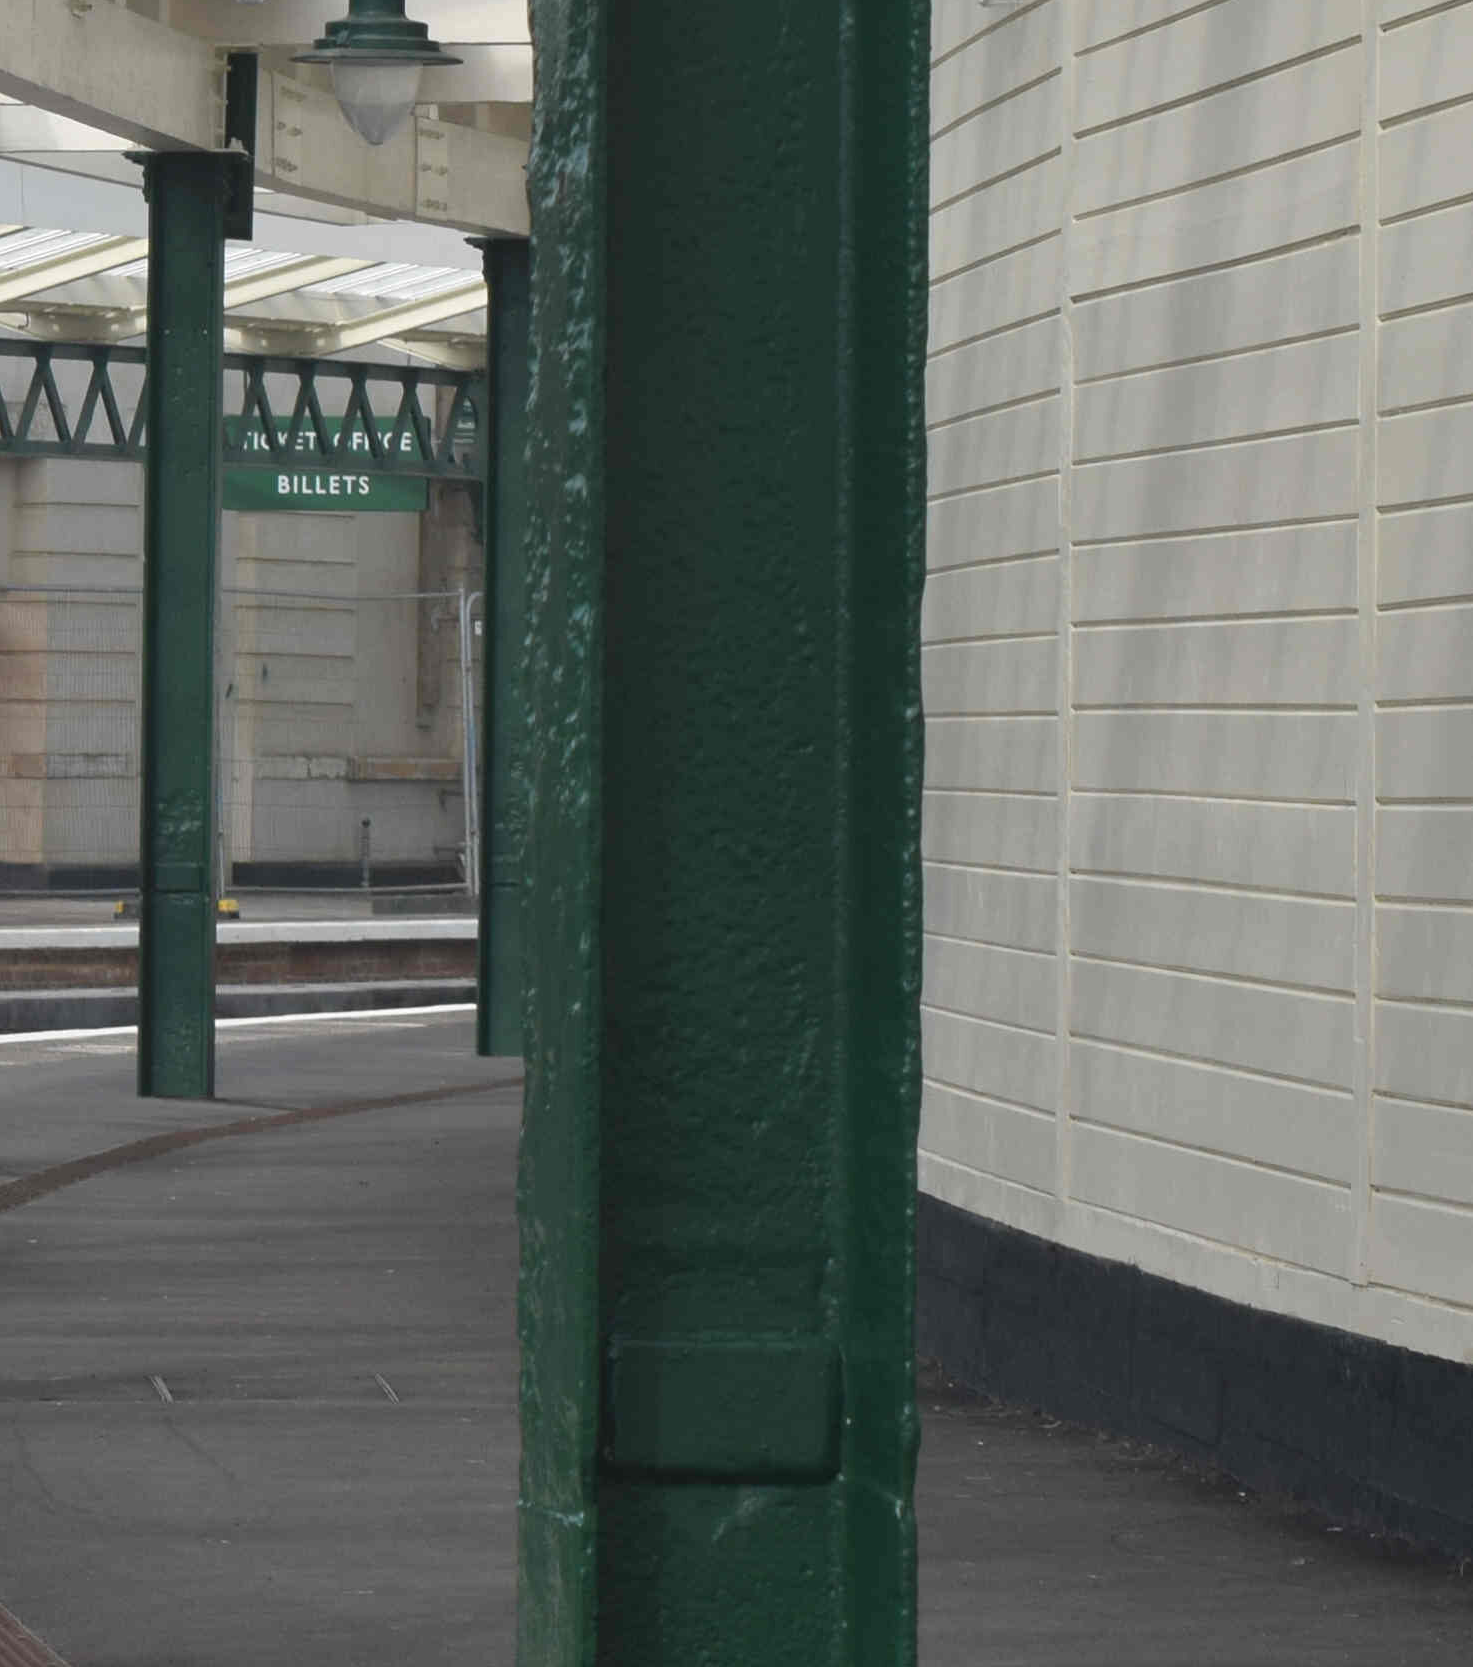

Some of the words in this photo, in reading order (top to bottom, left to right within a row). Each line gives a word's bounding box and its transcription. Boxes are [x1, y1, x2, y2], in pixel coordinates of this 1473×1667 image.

[242, 430, 317, 451] ICET
[332, 430, 413, 452] FCE
[277, 474, 371, 496] BILLETS
